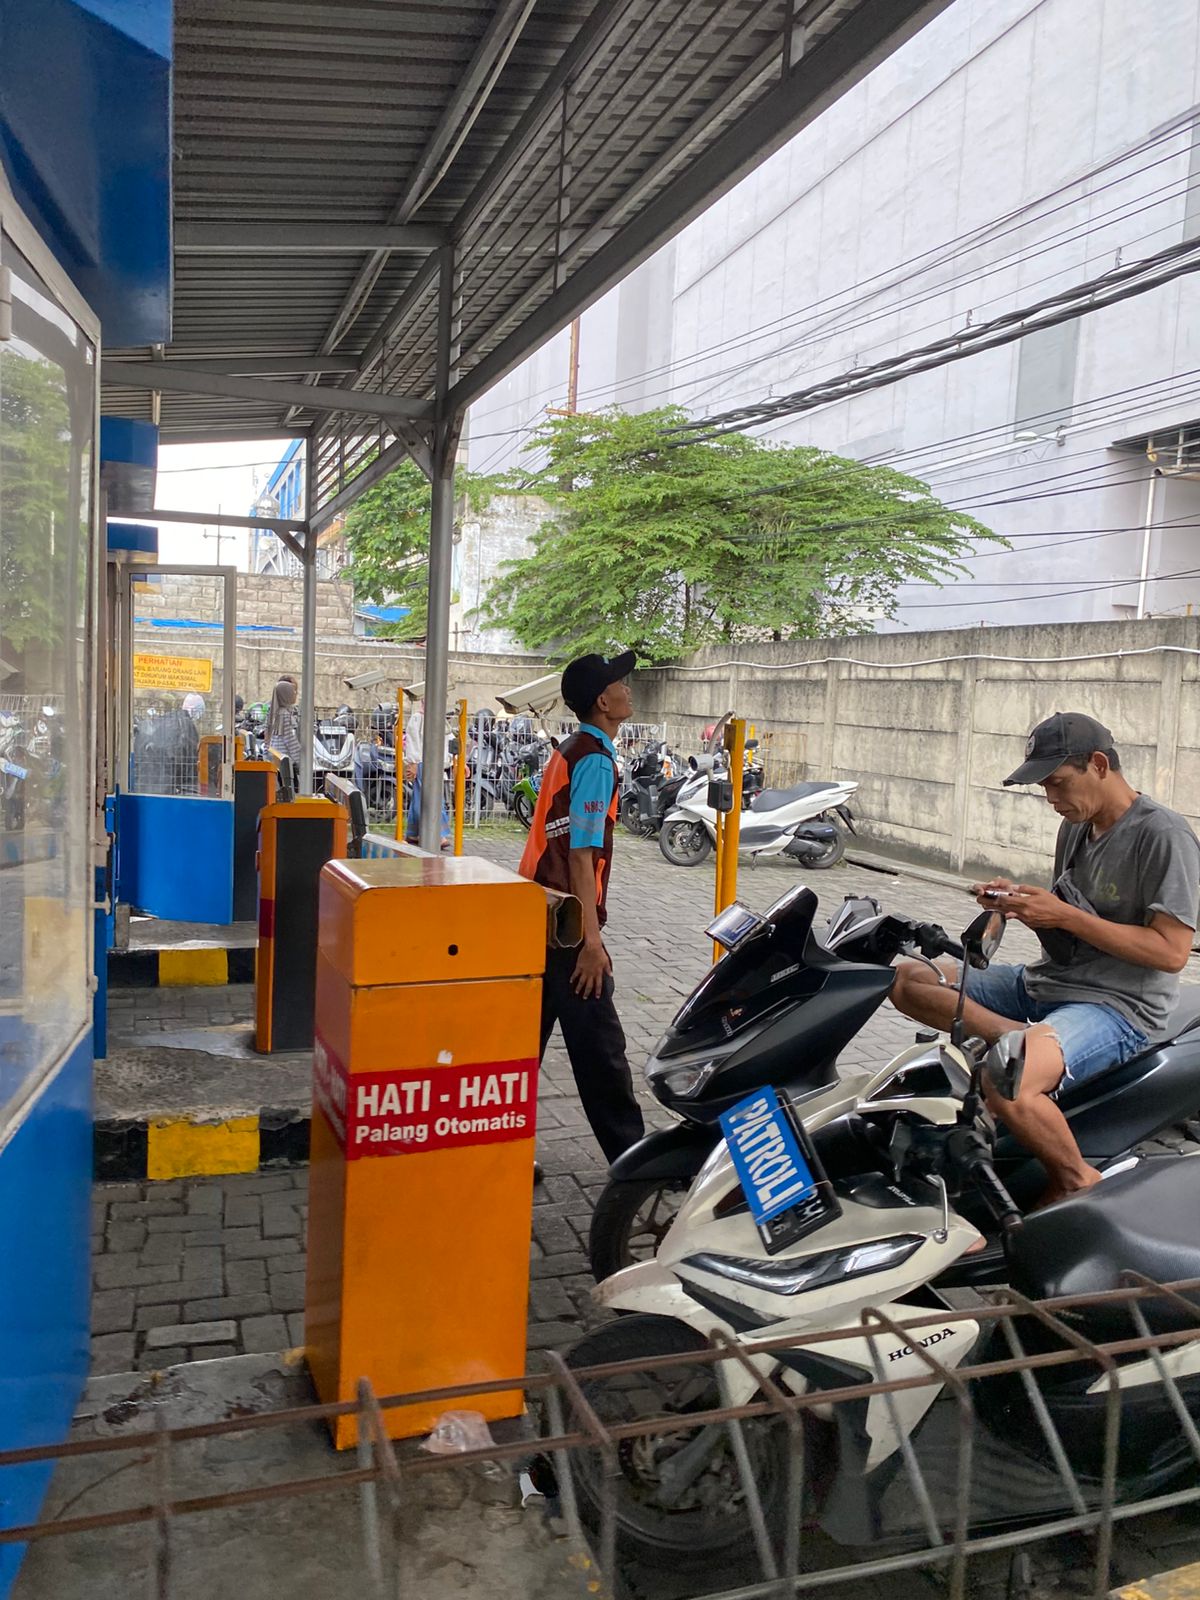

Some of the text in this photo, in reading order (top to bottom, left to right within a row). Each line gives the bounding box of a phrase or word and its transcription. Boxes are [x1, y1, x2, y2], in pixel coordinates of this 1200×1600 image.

[139, 657, 183, 667] PERHATIAN
[356, 1080, 431, 1118] HATI
[459, 1071, 529, 1108] HATI
[355, 1111, 527, 1144] Palang Otomatis
[728, 1097, 805, 1212] PATROLI
